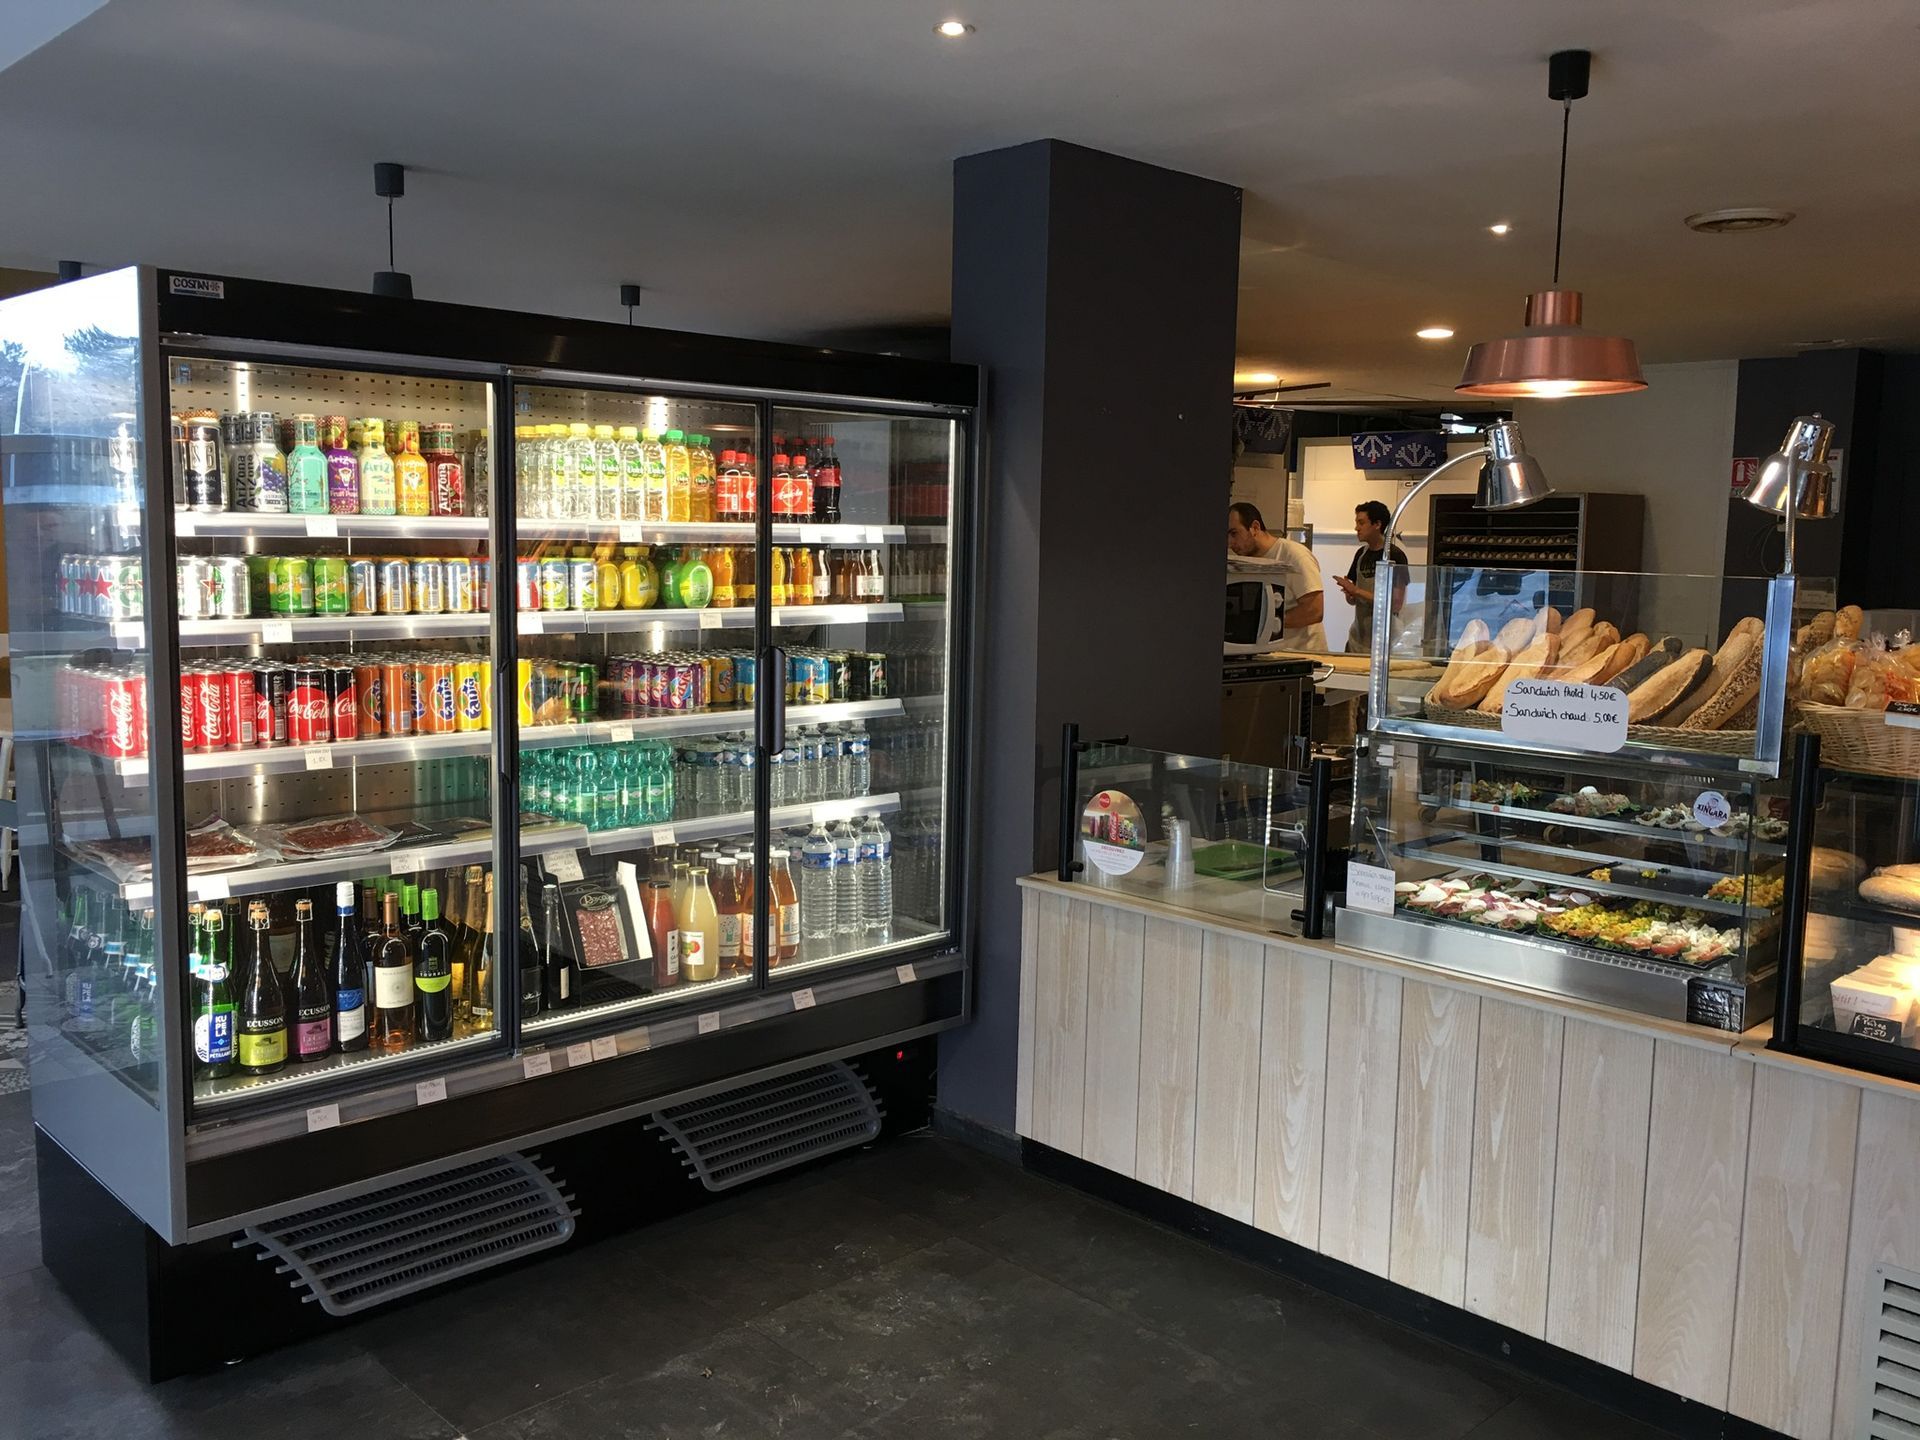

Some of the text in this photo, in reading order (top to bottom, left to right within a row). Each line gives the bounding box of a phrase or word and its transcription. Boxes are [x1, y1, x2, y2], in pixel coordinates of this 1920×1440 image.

[173, 277, 210, 291] COSTAN
[438, 464, 452, 513] AriZona
[1511, 681, 1560, 698] Sandwich
[1508, 703, 1557, 720] Sandwich
[299, 1003, 331, 1016] ECUSSON
[215, 1014, 227, 1022] KU
[246, 1015, 284, 1028] ECUSSON
[215, 1029, 227, 1038] LA
